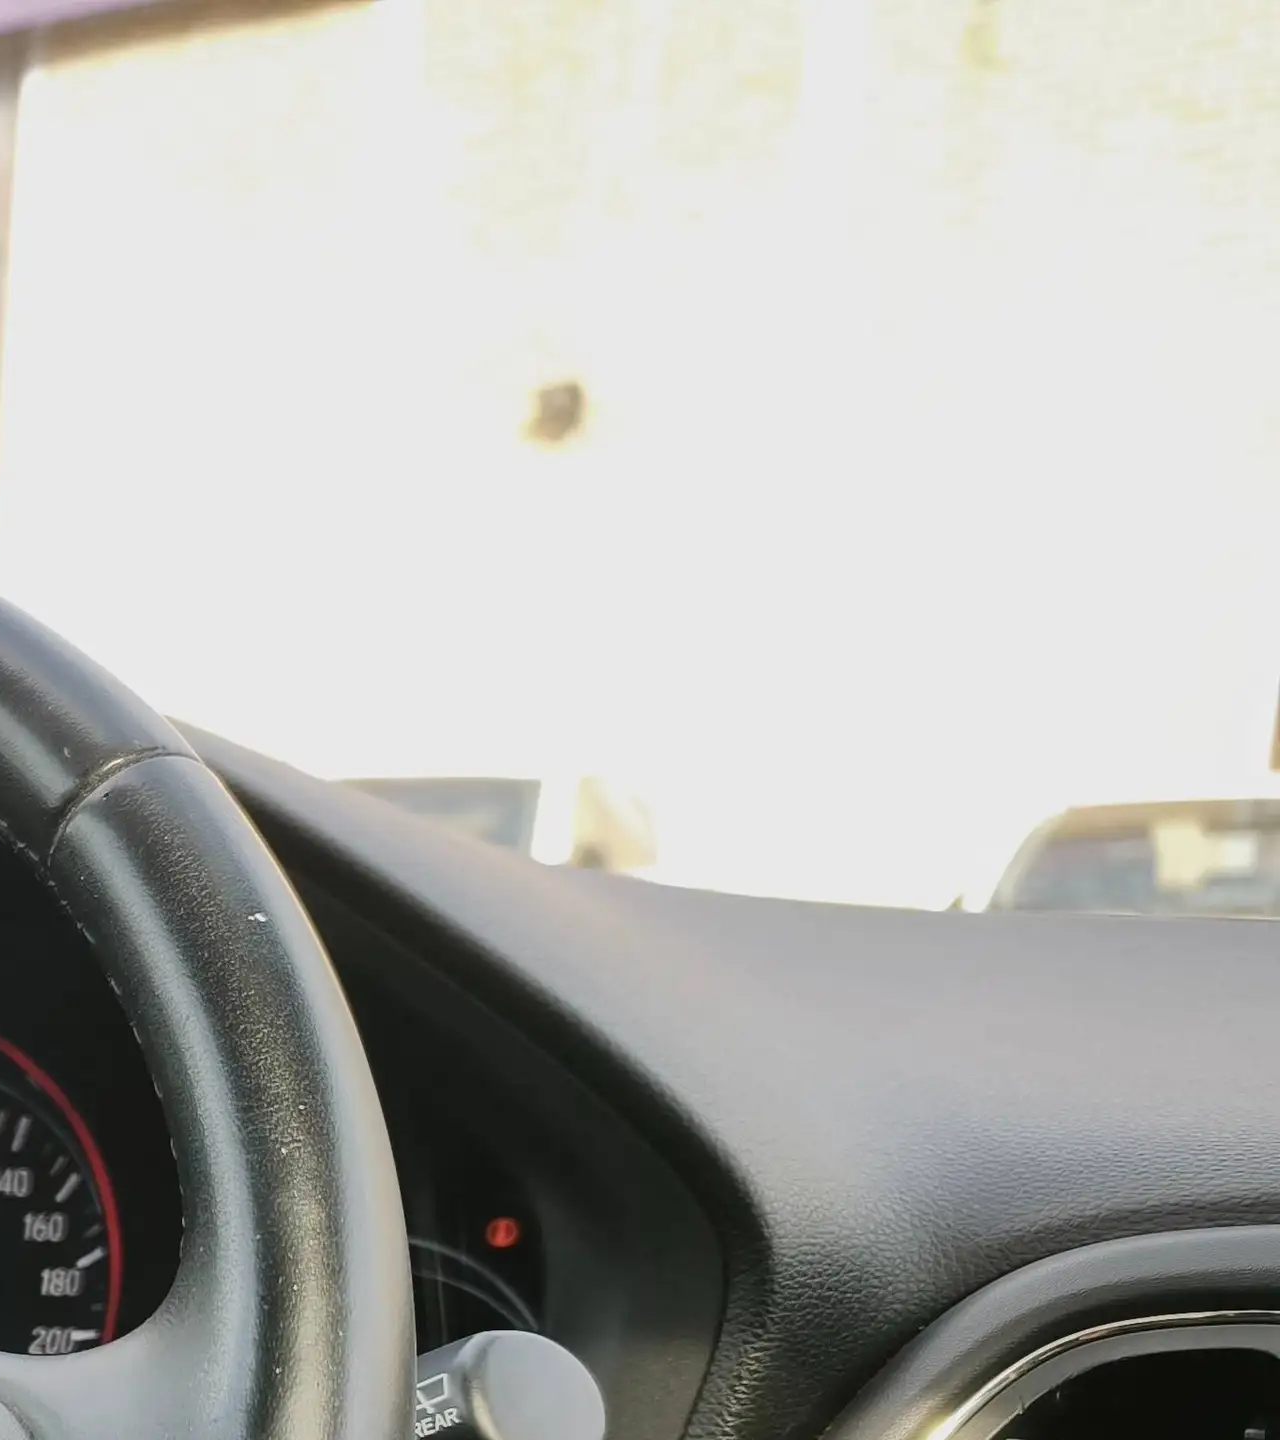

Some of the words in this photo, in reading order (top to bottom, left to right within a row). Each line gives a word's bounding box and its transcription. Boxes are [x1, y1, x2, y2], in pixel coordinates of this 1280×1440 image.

[22, 1211, 68, 1243] 160
[40, 1267, 85, 1297] 180
[28, 1325, 77, 1355] 200
[414, 1407, 462, 1440] REAR
